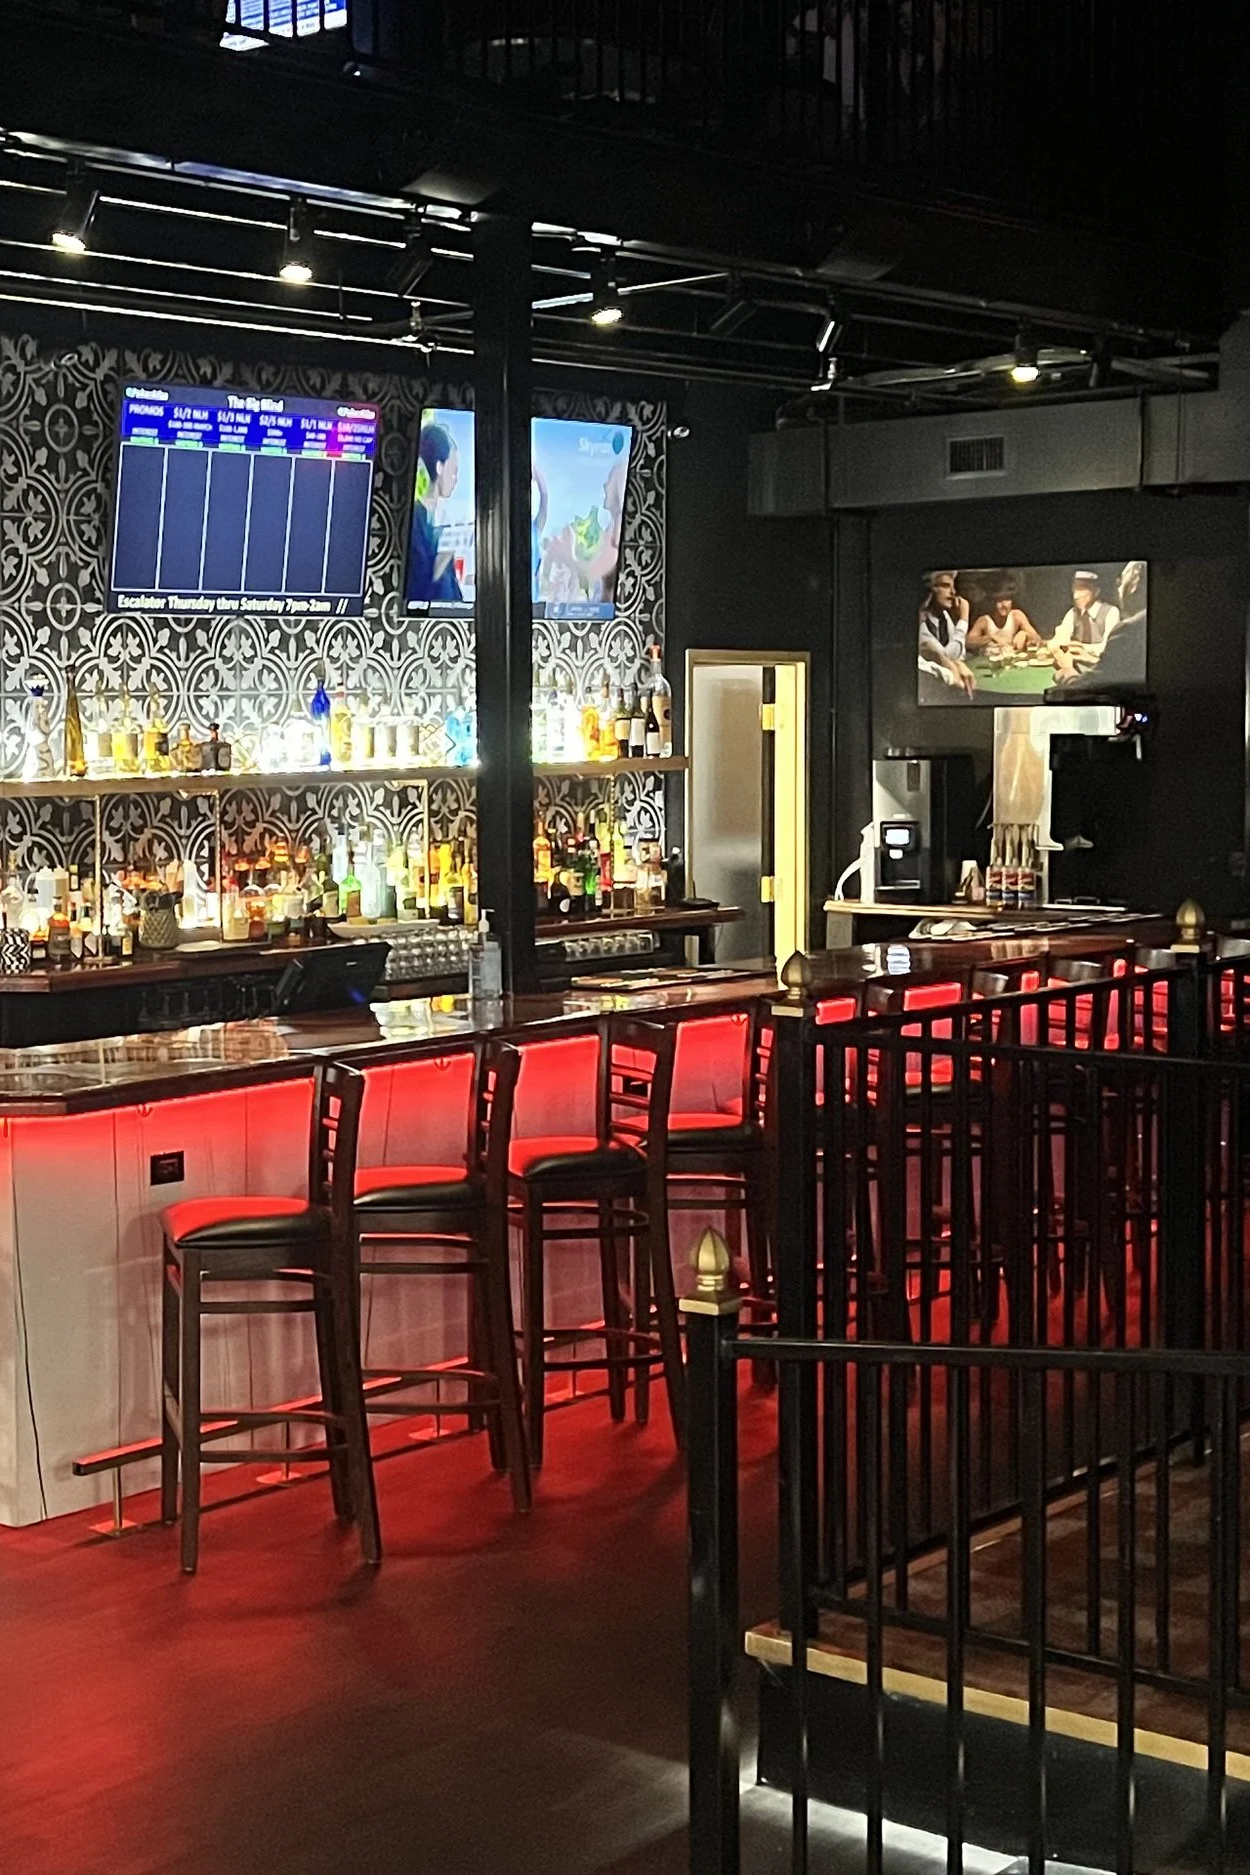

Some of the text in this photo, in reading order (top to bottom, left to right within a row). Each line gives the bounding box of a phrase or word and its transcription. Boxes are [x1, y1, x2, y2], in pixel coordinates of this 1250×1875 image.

[129, 404, 164, 416] PROMOS
[227, 396, 284, 413] The Big Blind
[118, 594, 166, 609] Escalator
[168, 595, 215, 612] Thursday
[216, 597, 239, 610] thru
[240, 597, 285, 613] Saturday
